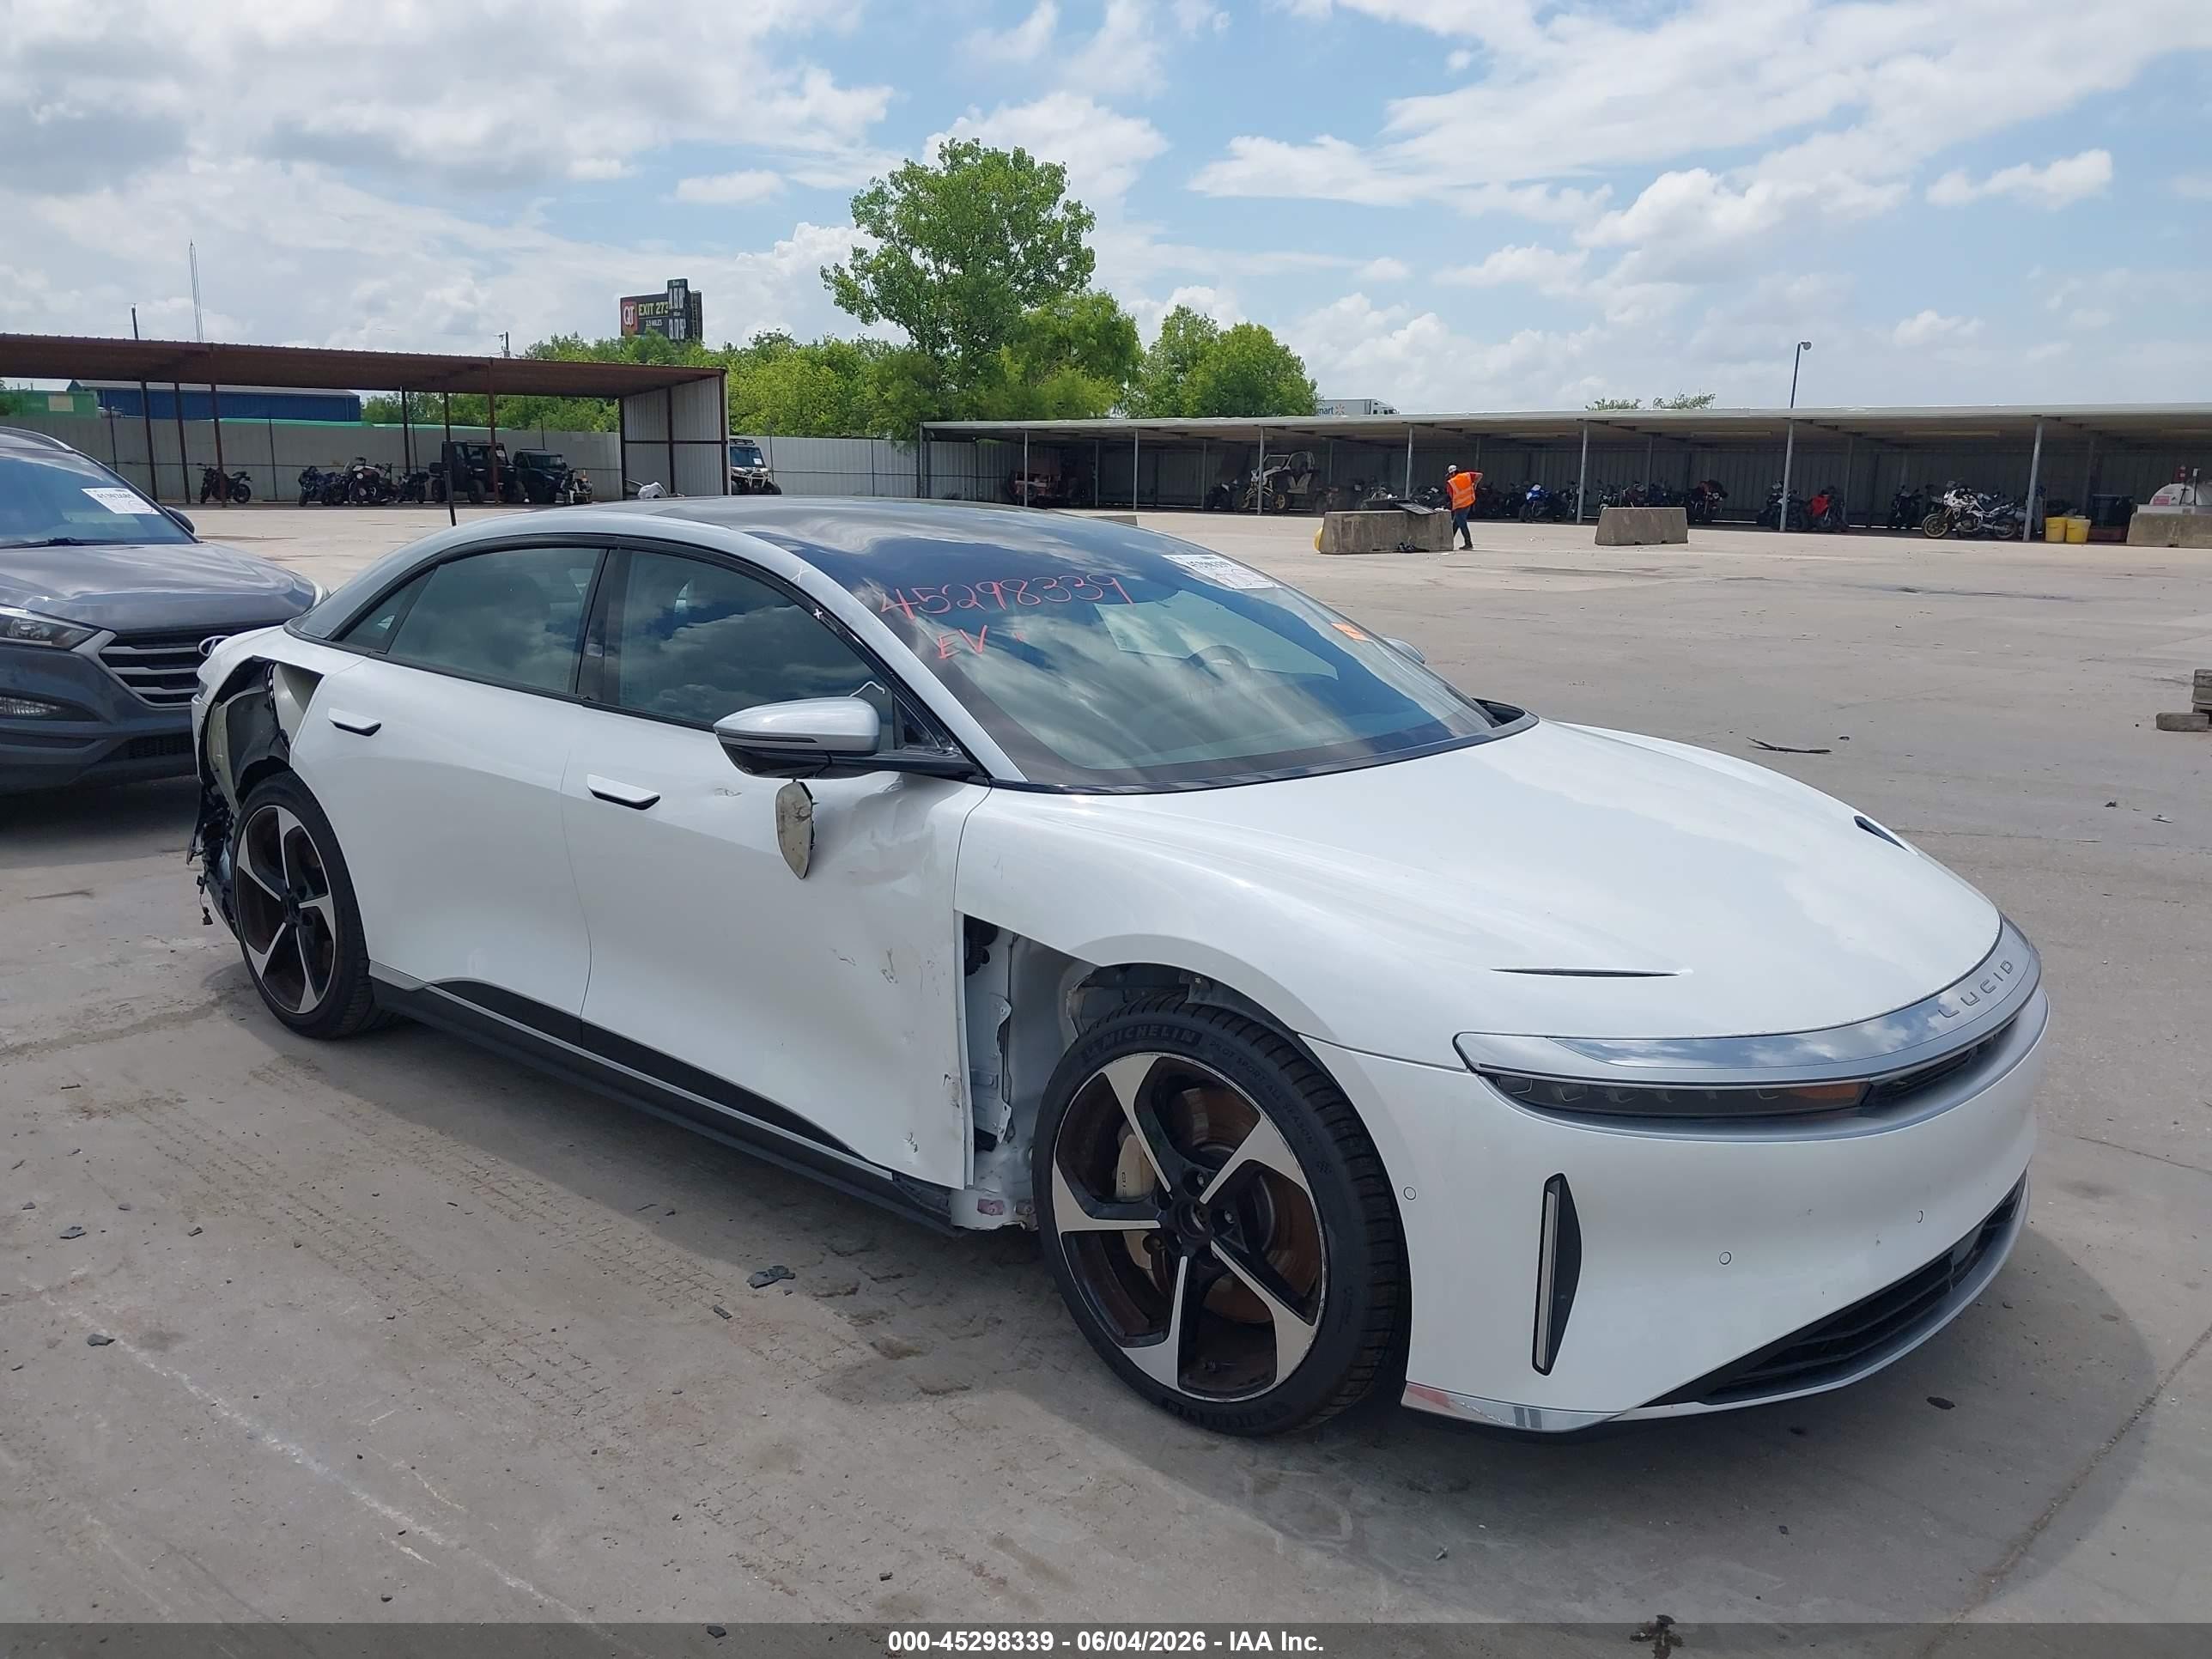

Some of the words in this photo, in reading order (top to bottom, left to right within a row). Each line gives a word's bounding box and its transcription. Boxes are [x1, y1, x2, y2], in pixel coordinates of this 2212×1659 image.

[623, 306, 635, 326] QT
[638, 302, 654, 316] EXIT
[655, 301, 669, 314] 273
[1316, 406, 1334, 415] mart
[880, 574, 1134, 620] 45298339
[939, 624, 988, 659] EV
[1937, 960, 2014, 1018] LUCID
[1103, 1024, 1197, 1052] MICHELIN
